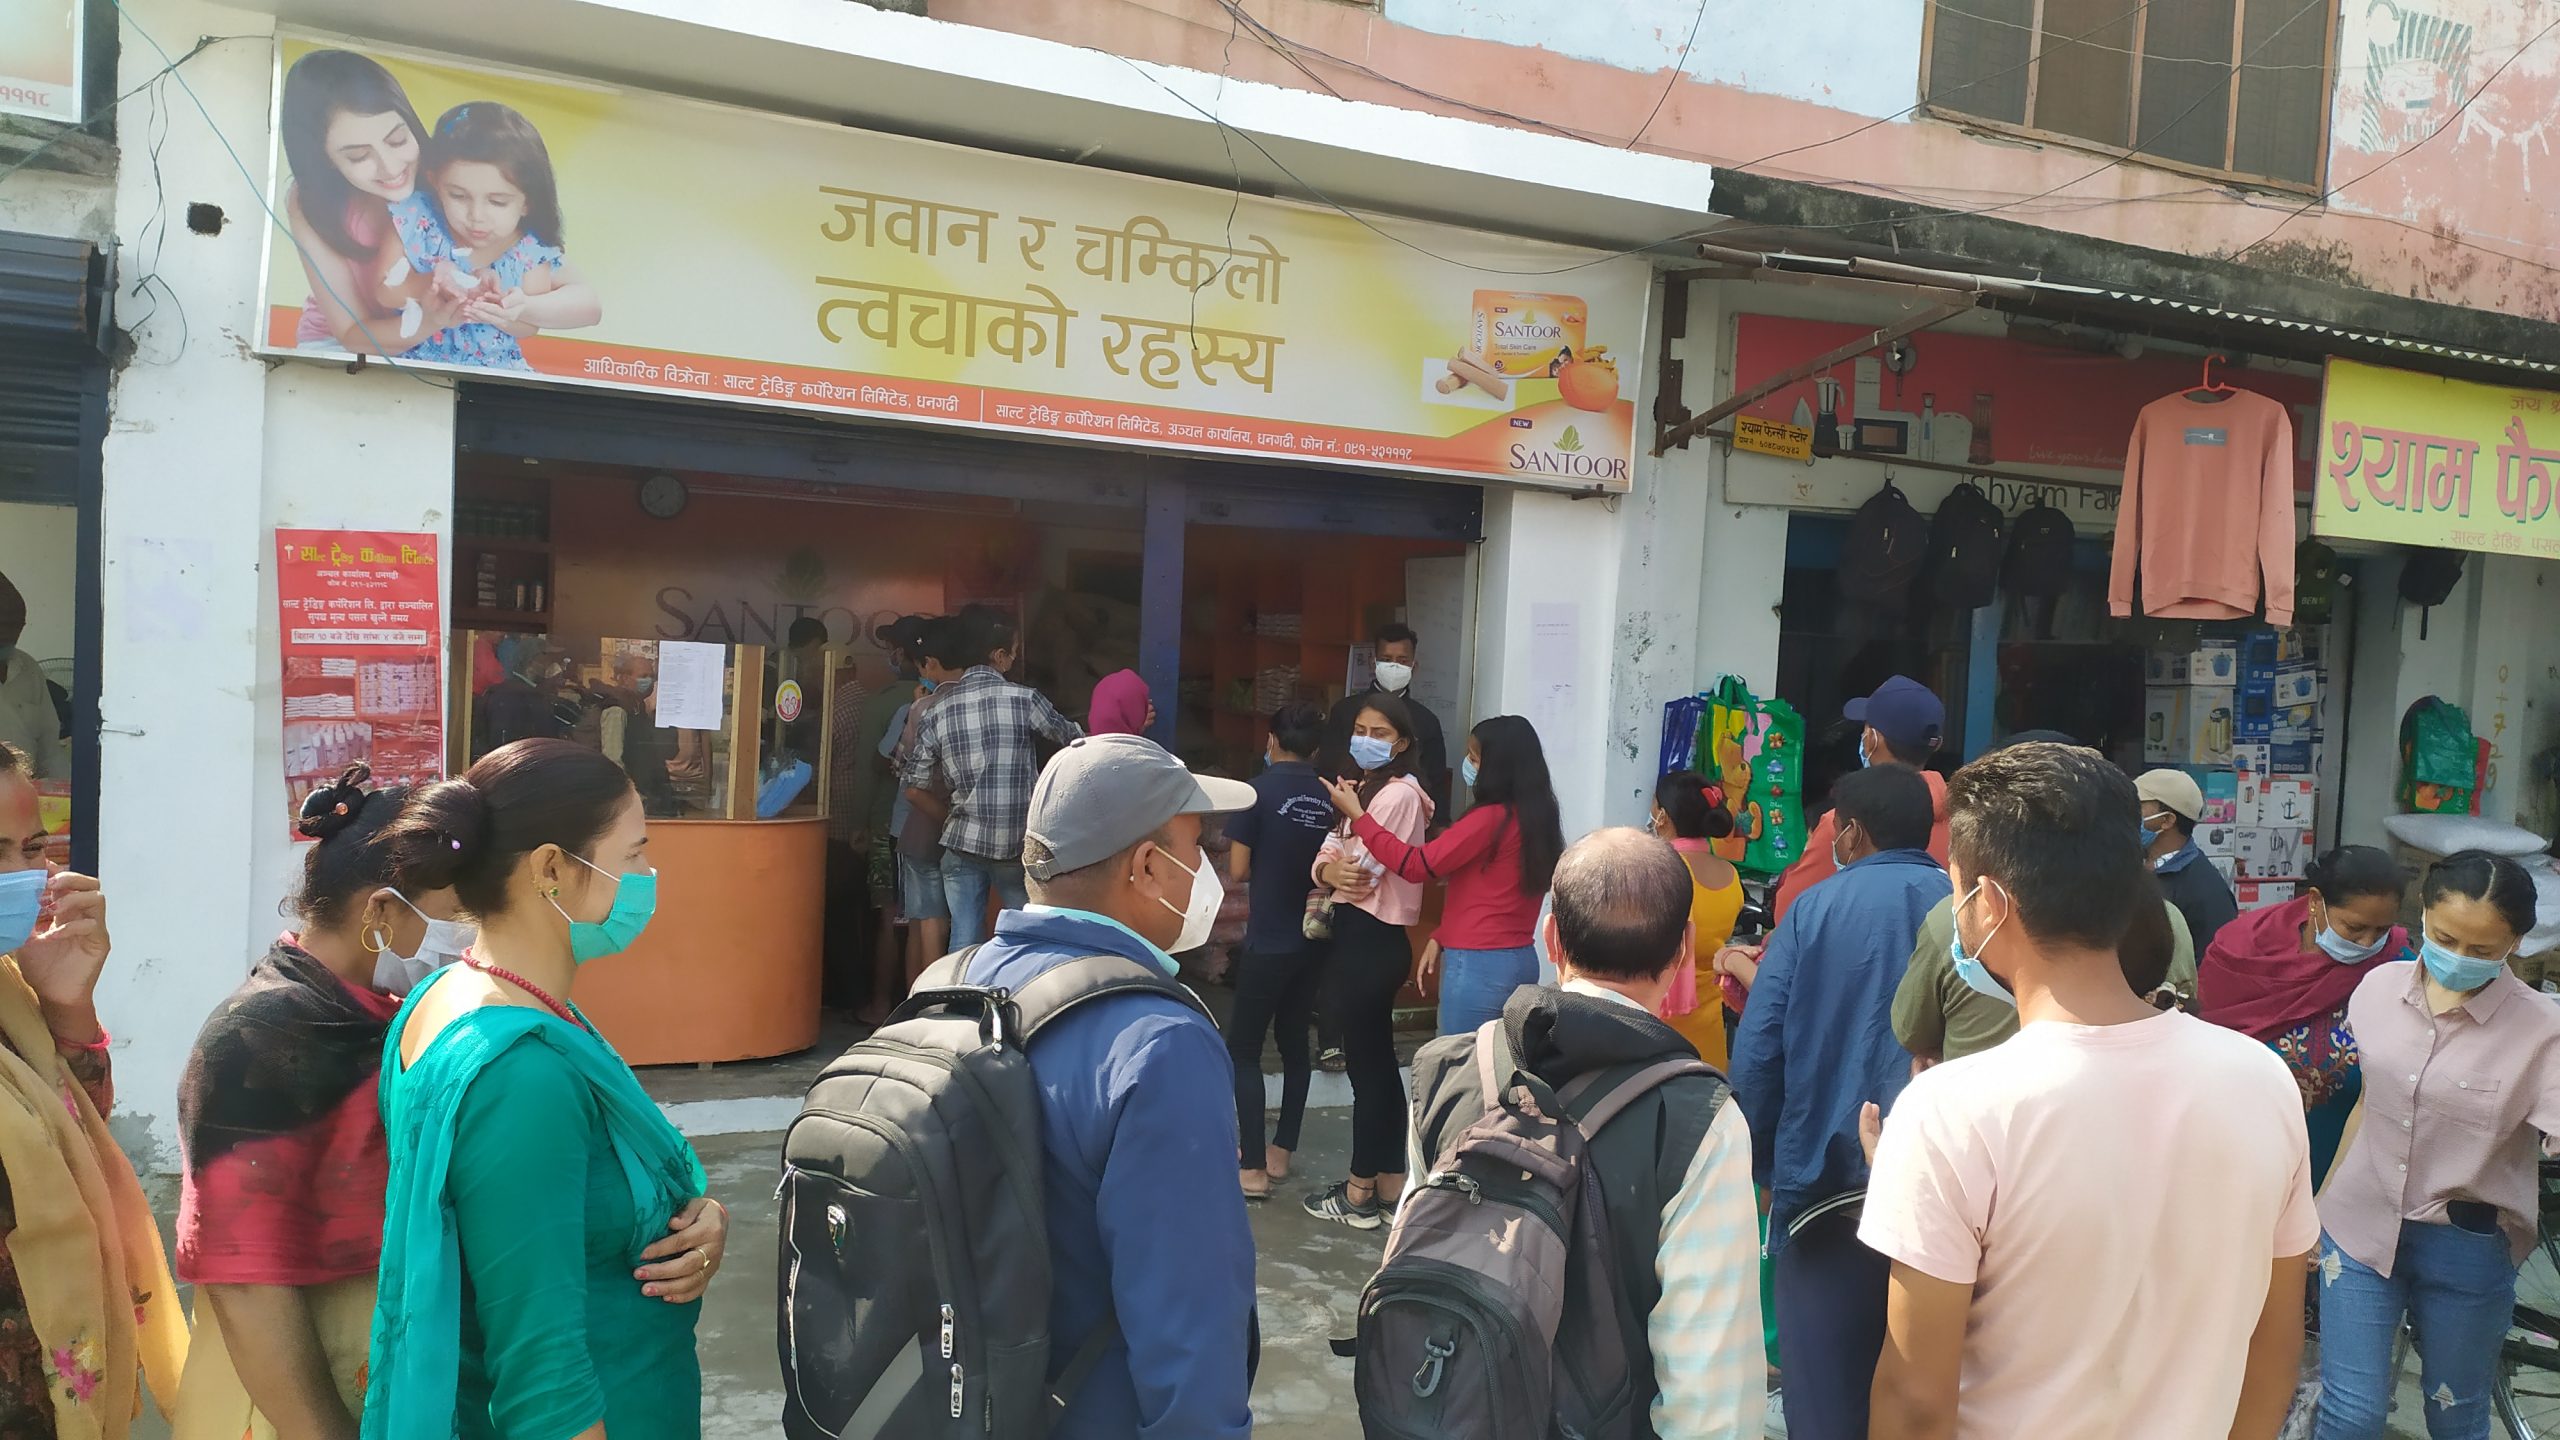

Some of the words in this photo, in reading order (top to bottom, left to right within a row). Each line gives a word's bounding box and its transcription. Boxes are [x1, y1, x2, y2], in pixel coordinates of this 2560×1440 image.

[819, 185, 998, 264] जवान
[1017, 215, 1057, 271] र
[1074, 215, 1290, 305] चम्किलो
[815, 275, 1079, 369] त्वचाको
[1100, 314, 1285, 394] रहस्य
[1495, 321, 1561, 338] SANTOOR
[664, 363, 710, 387] विक्रेता
[722, 374, 757, 391] साल्ट
[860, 385, 911, 408] लिमिटेड,
[2510, 395, 2544, 413] जय
[996, 403, 1025, 420] साल्ट
[1117, 414, 1163, 435] लिमिटेड,
[1300, 435, 1324, 451] फोन
[1512, 419, 1530, 427] NEW
[1741, 421, 1762, 436] श्याम
[1788, 427, 1809, 444] स्टोर
[1509, 443, 1628, 480] SANTOOR
[2328, 420, 2481, 518] श्याम
[655, 587, 922, 650] SANTOO
